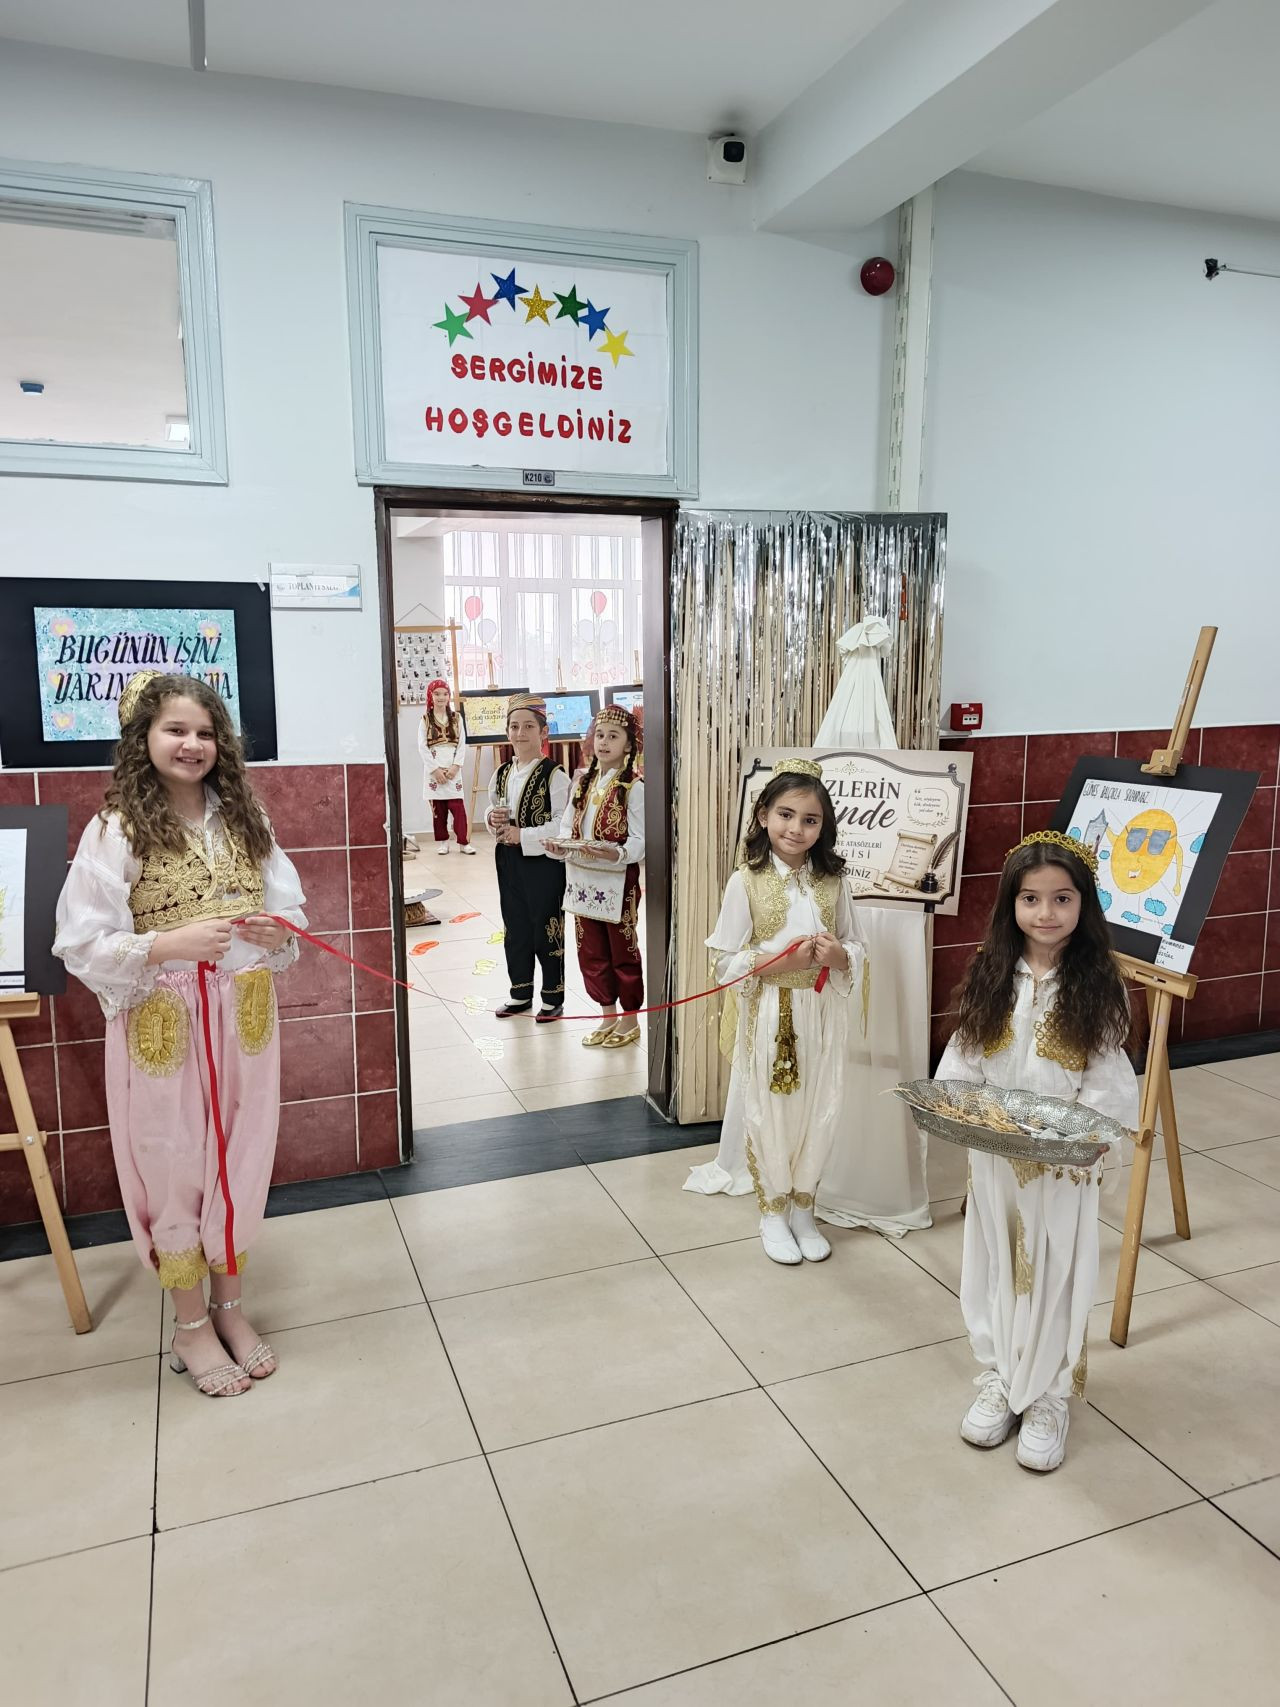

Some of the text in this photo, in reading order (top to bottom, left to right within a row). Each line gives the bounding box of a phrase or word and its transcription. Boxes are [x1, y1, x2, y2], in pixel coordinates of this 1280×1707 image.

[450, 351, 603, 391] SERGİMİZE
[425, 406, 632, 444] HOŞGELDİNİZ
[525, 472, 542, 482] K210
[54, 631, 223, 668] BUGÜNÜN İŞİNİ
[54, 672, 137, 704] YARIN
[825, 777, 902, 800] ZLERİN
[833, 800, 898, 831] nde
[833, 849, 871, 859] GİSİ
[846, 841, 882, 849] ATASÖZLERİ
[843, 865, 871, 879] DİNİZ
